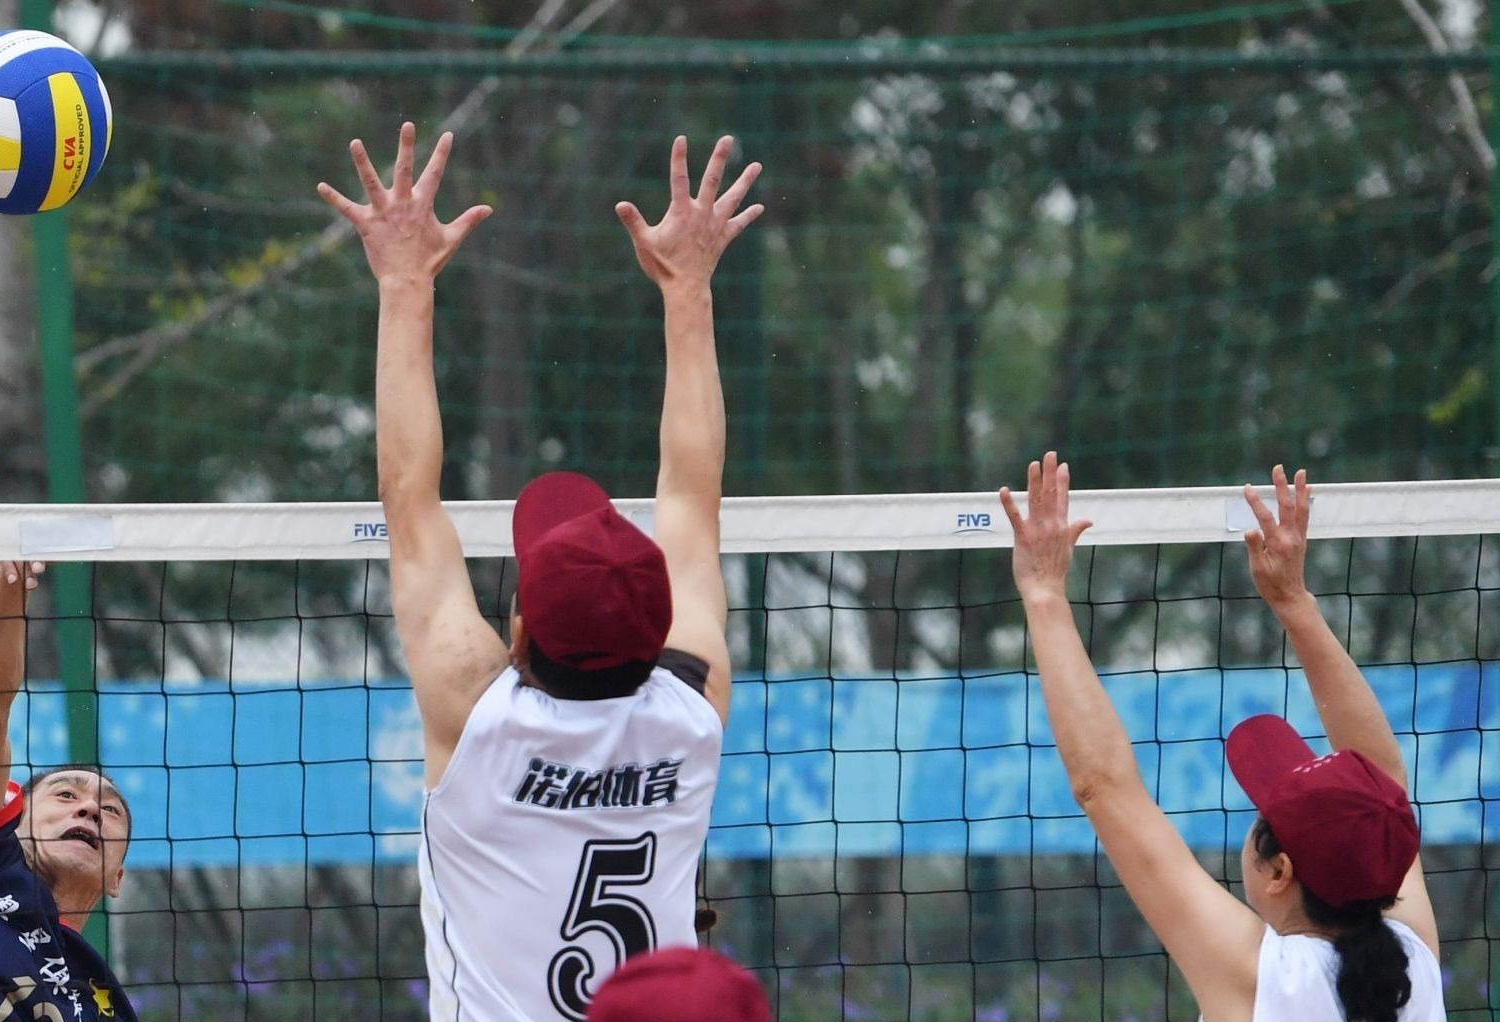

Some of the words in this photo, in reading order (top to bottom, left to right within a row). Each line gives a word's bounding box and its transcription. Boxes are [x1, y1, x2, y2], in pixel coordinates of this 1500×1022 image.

[75, 104, 85, 156] APPROVED
[63, 136, 76, 171] CVA
[957, 513, 991, 528] FIVB
[513, 757, 687, 810] 诺伯体育
